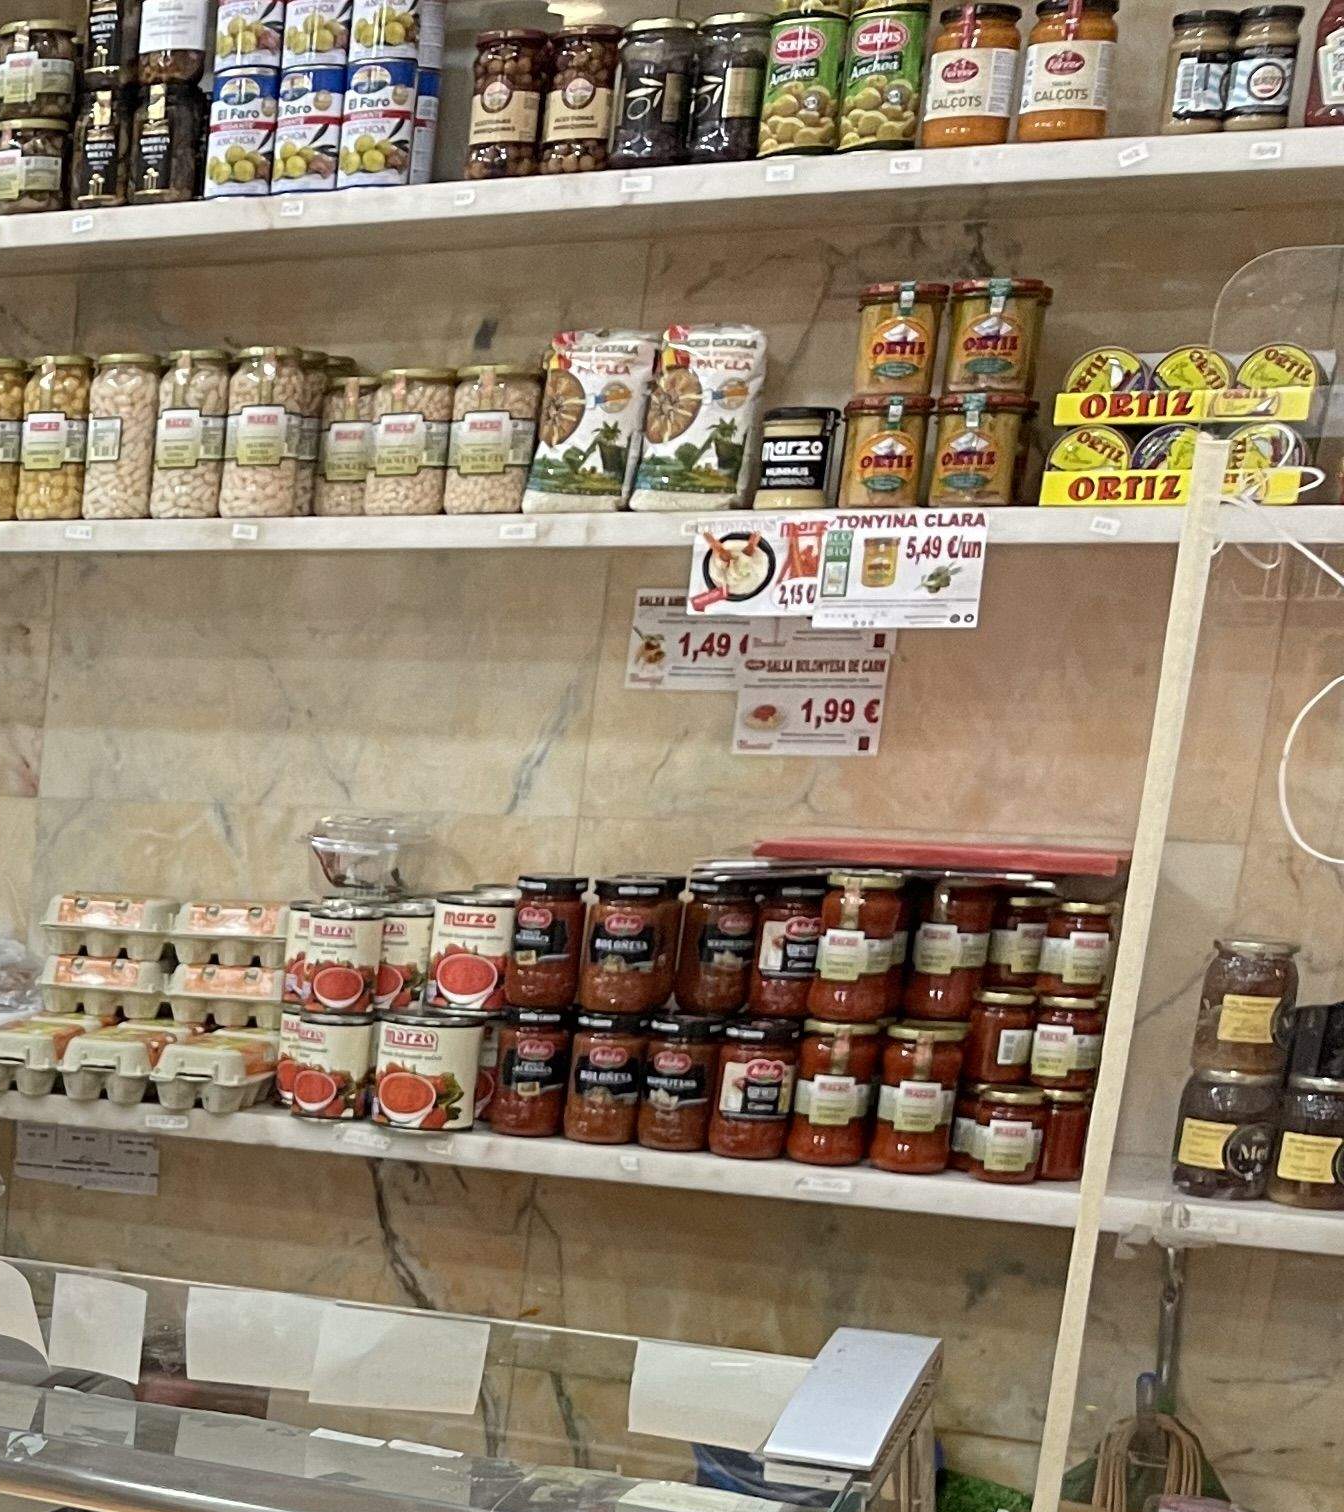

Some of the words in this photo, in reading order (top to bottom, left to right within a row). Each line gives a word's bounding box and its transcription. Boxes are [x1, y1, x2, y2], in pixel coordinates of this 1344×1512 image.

[230, 107, 260, 119] Faro
[360, 97, 390, 108] Faro
[1264, 348, 1313, 382] ORTIZ
[1079, 391, 1194, 419] ORTIZ
[1076, 430, 1125, 464] ORTIZ
[1067, 475, 1182, 501] ORTIZ
[835, 514, 918, 529] TONYINA
[924, 512, 987, 528] CLARA
[905, 535, 942, 564] 5,49
[778, 583, 804, 610] 2,15
[678, 631, 731, 663] 1,49
[800, 698, 856, 730] 1,99
[863, 698, 881, 724] €
[443, 909, 497, 930] marzo
[385, 1029, 437, 1051] marzo
